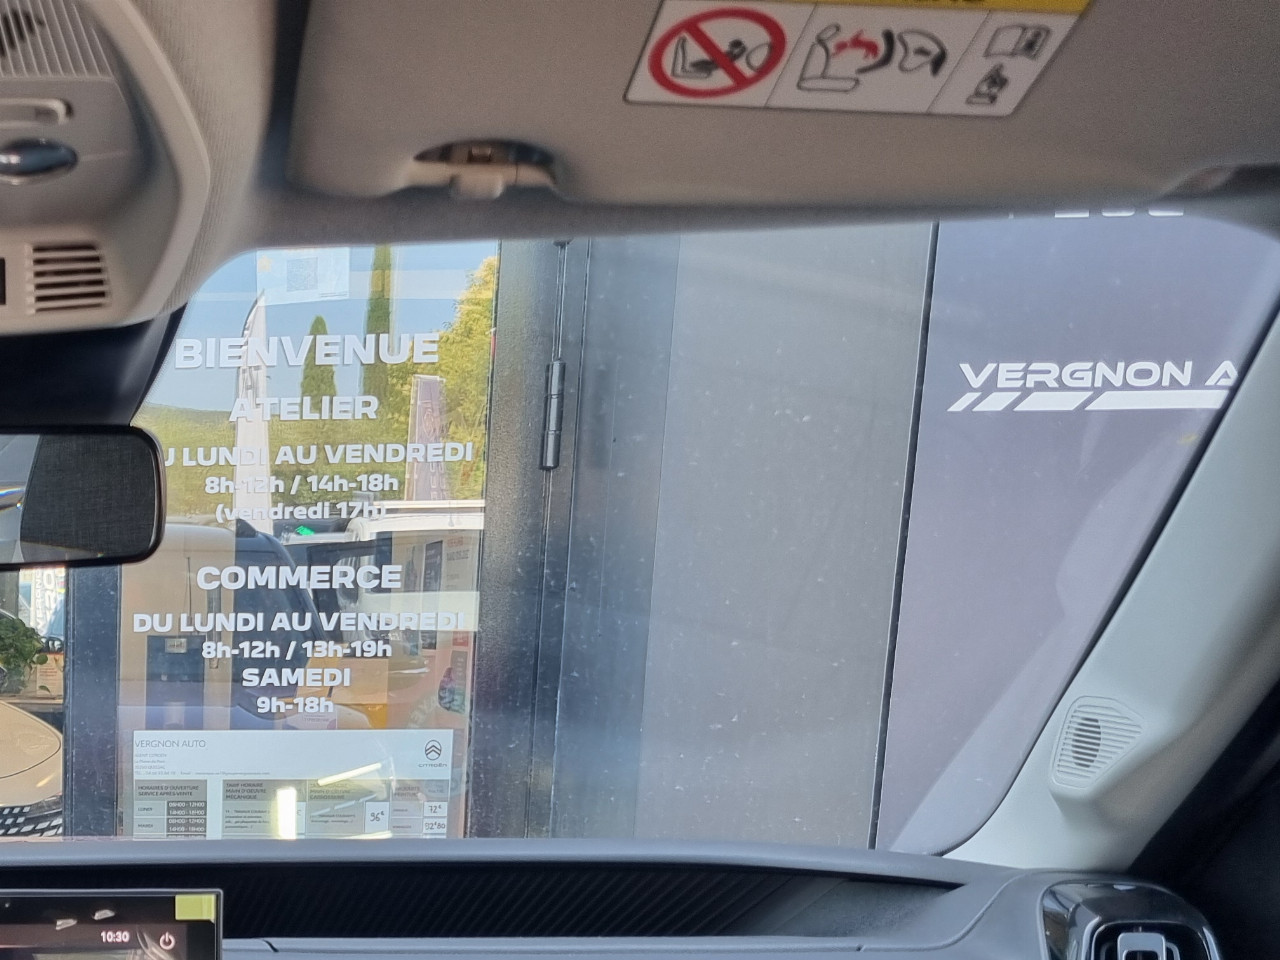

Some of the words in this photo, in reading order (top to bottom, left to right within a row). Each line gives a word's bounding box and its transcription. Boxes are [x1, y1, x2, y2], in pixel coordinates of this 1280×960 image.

[175, 333, 440, 369] BIENVENUE
[959, 361, 1193, 388] VERGNON
[229, 395, 379, 422] ATELIER
[182, 446, 267, 467] LUNDI
[275, 445, 317, 465] AU
[321, 442, 473, 464] VENDREDI
[205, 475, 284, 494] 8h-12h
[290, 475, 300, 495] /
[307, 474, 398, 492] 14h-18h
[216, 502, 330, 523] (vendredi
[336, 501, 386, 520] 17h)
[197, 564, 402, 590] COMMERCE
[133, 613, 172, 633] DU
[180, 613, 263, 632] LUNDI
[271, 613, 313, 632] AU
[320, 612, 465, 631] VENDREDI
[202, 641, 279, 659] 8h-12h
[285, 641, 295, 660] /
[302, 640, 392, 658] 13h-19h
[242, 668, 351, 687] SAMEDI
[256, 697, 334, 713] 9h-18h
[135, 740, 179, 748] VERGNON
[182, 740, 206, 748] AUTO
[101, 931, 130, 943] 10:30
